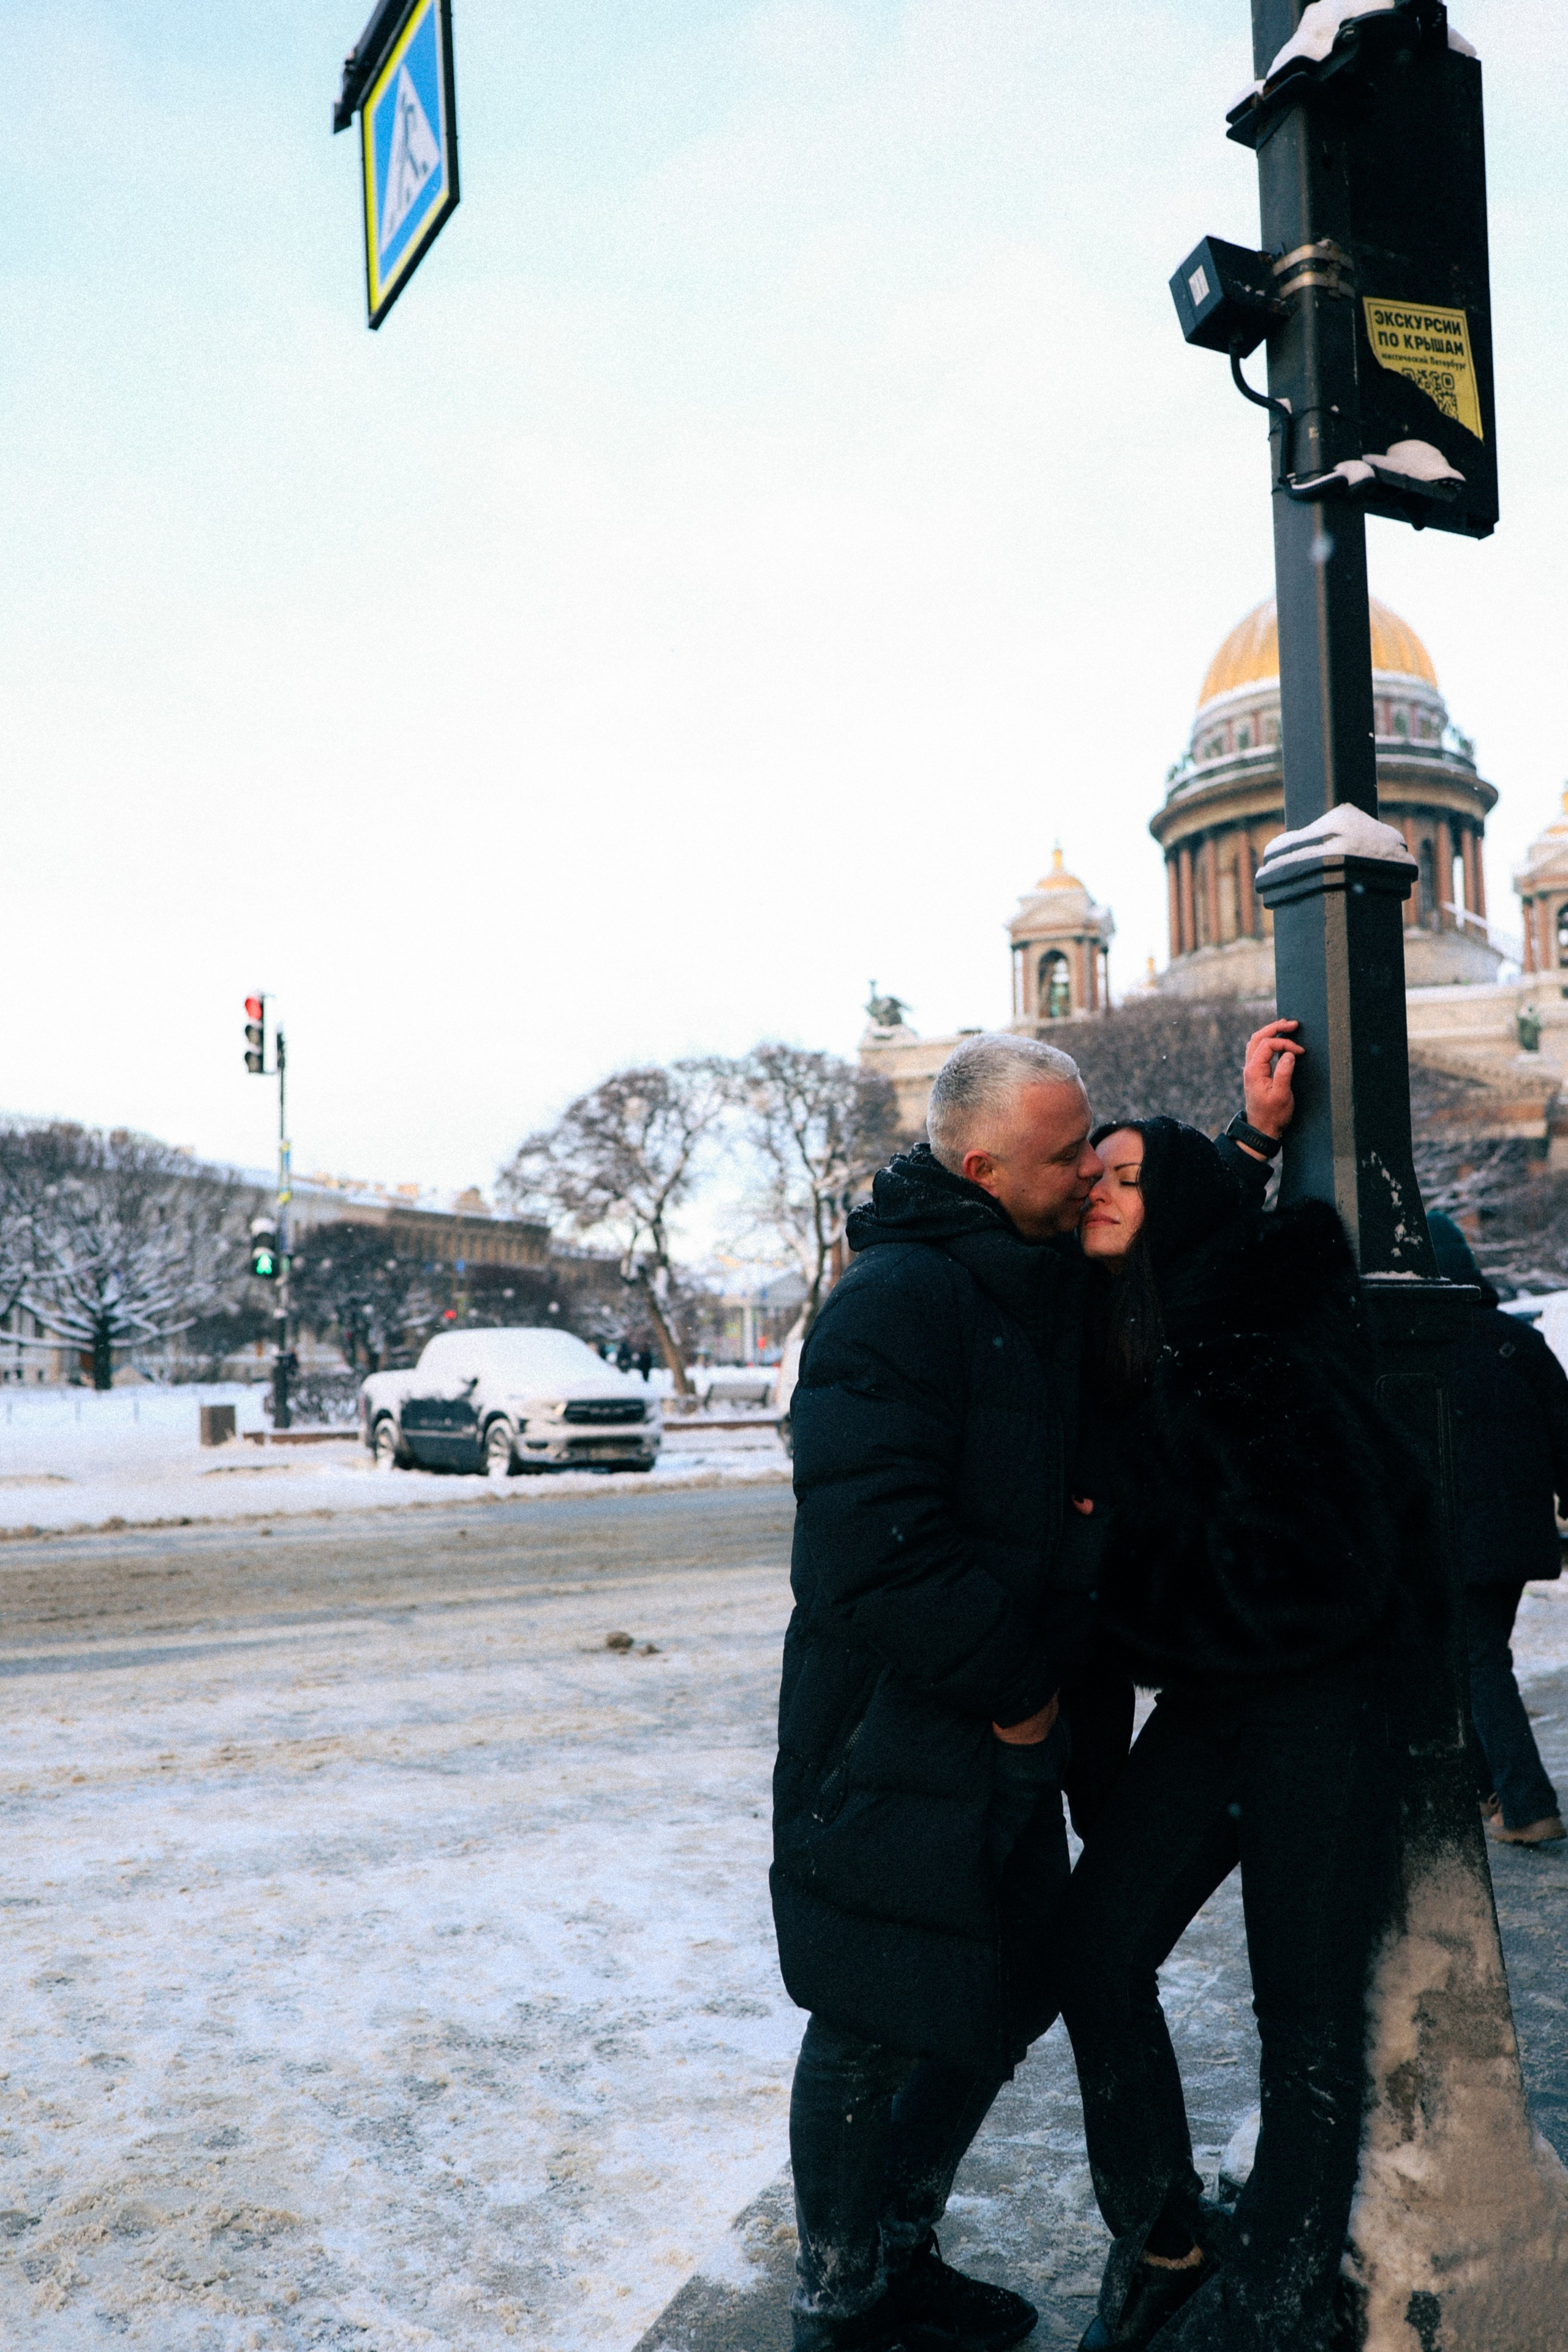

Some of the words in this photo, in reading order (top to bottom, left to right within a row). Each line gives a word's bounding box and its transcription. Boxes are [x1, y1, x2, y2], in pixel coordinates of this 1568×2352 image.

[1374, 309, 1461, 336] ЭКСКУРСИИ
[1378, 331, 1399, 347] ПО
[1403, 334, 1464, 356] КРЫШАМ
[1430, 356, 1466, 371] Петербург
